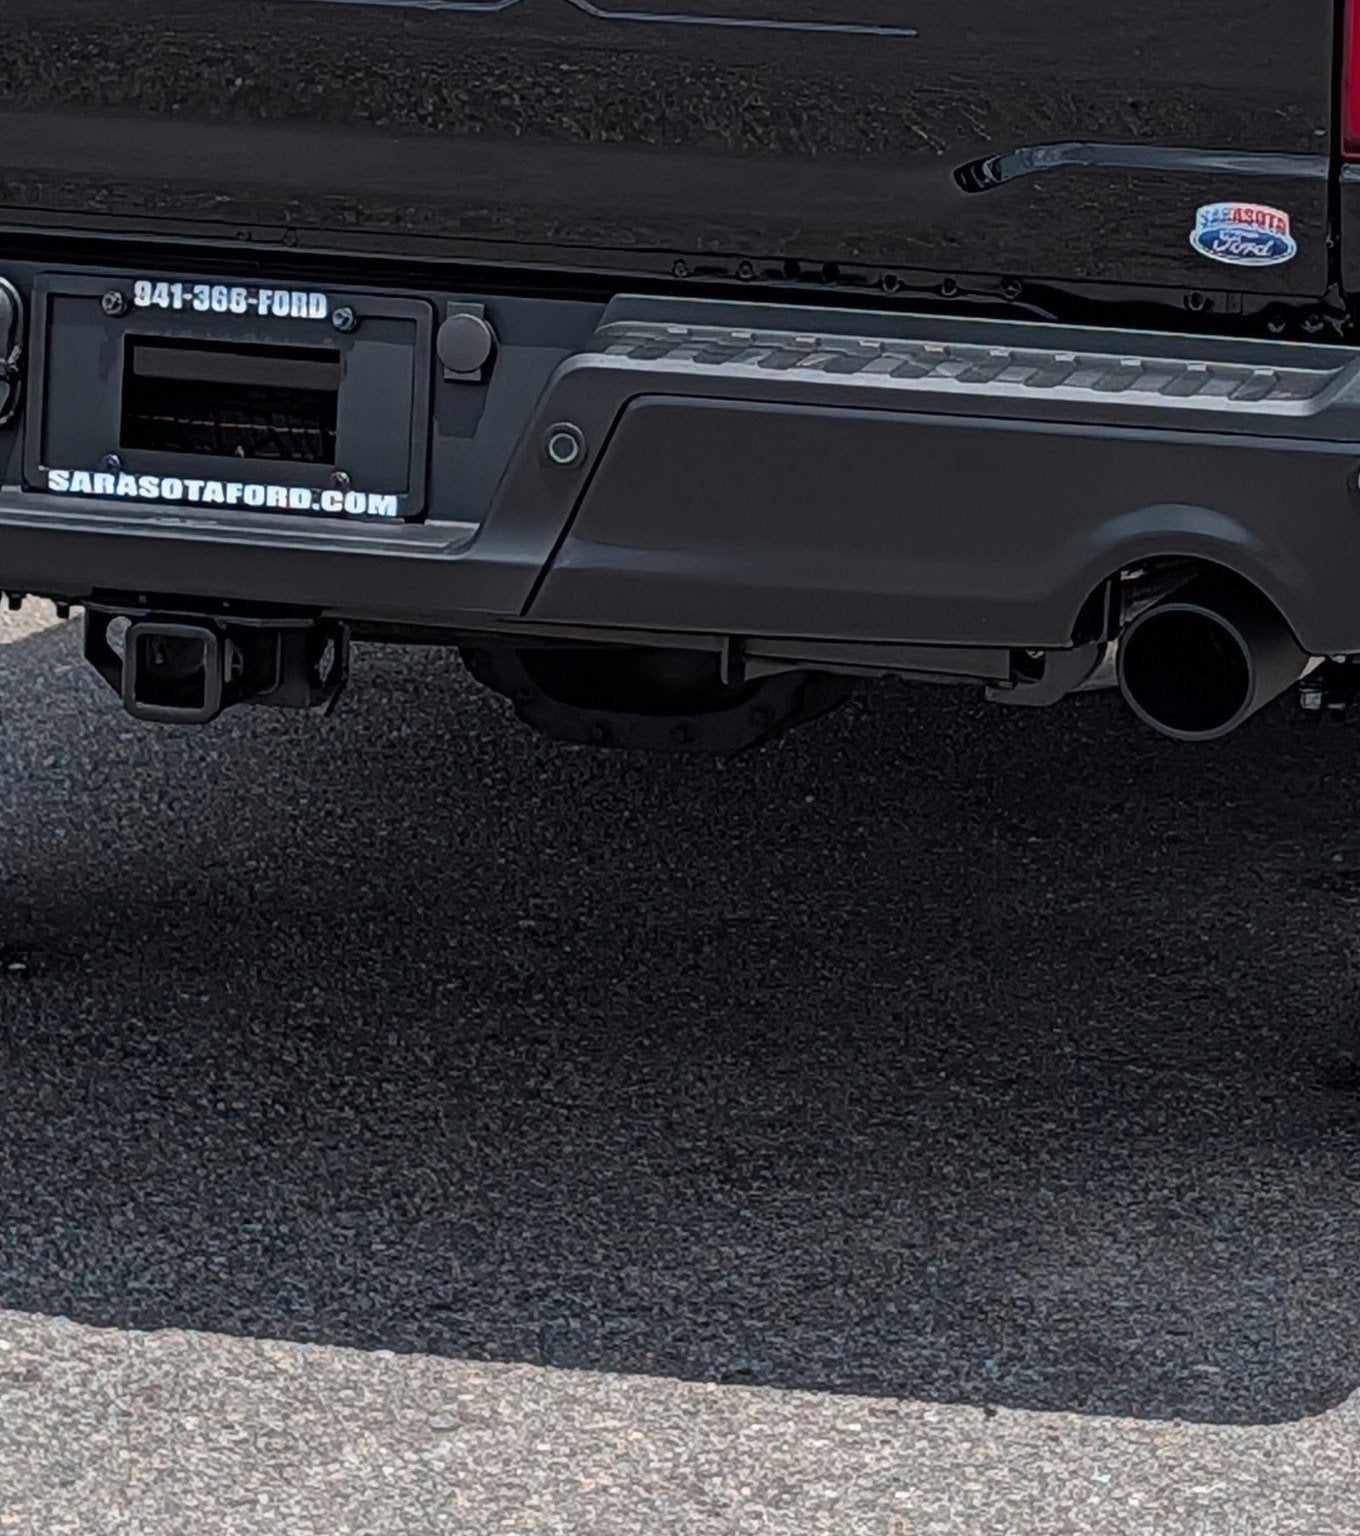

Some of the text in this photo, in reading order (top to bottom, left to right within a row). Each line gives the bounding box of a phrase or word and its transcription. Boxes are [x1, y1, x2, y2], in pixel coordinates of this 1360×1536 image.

[1212, 229, 1274, 257] Ford
[134, 279, 327, 319] 941-366-FORD
[47, 469, 399, 517] SARASOTAFORD.COM
